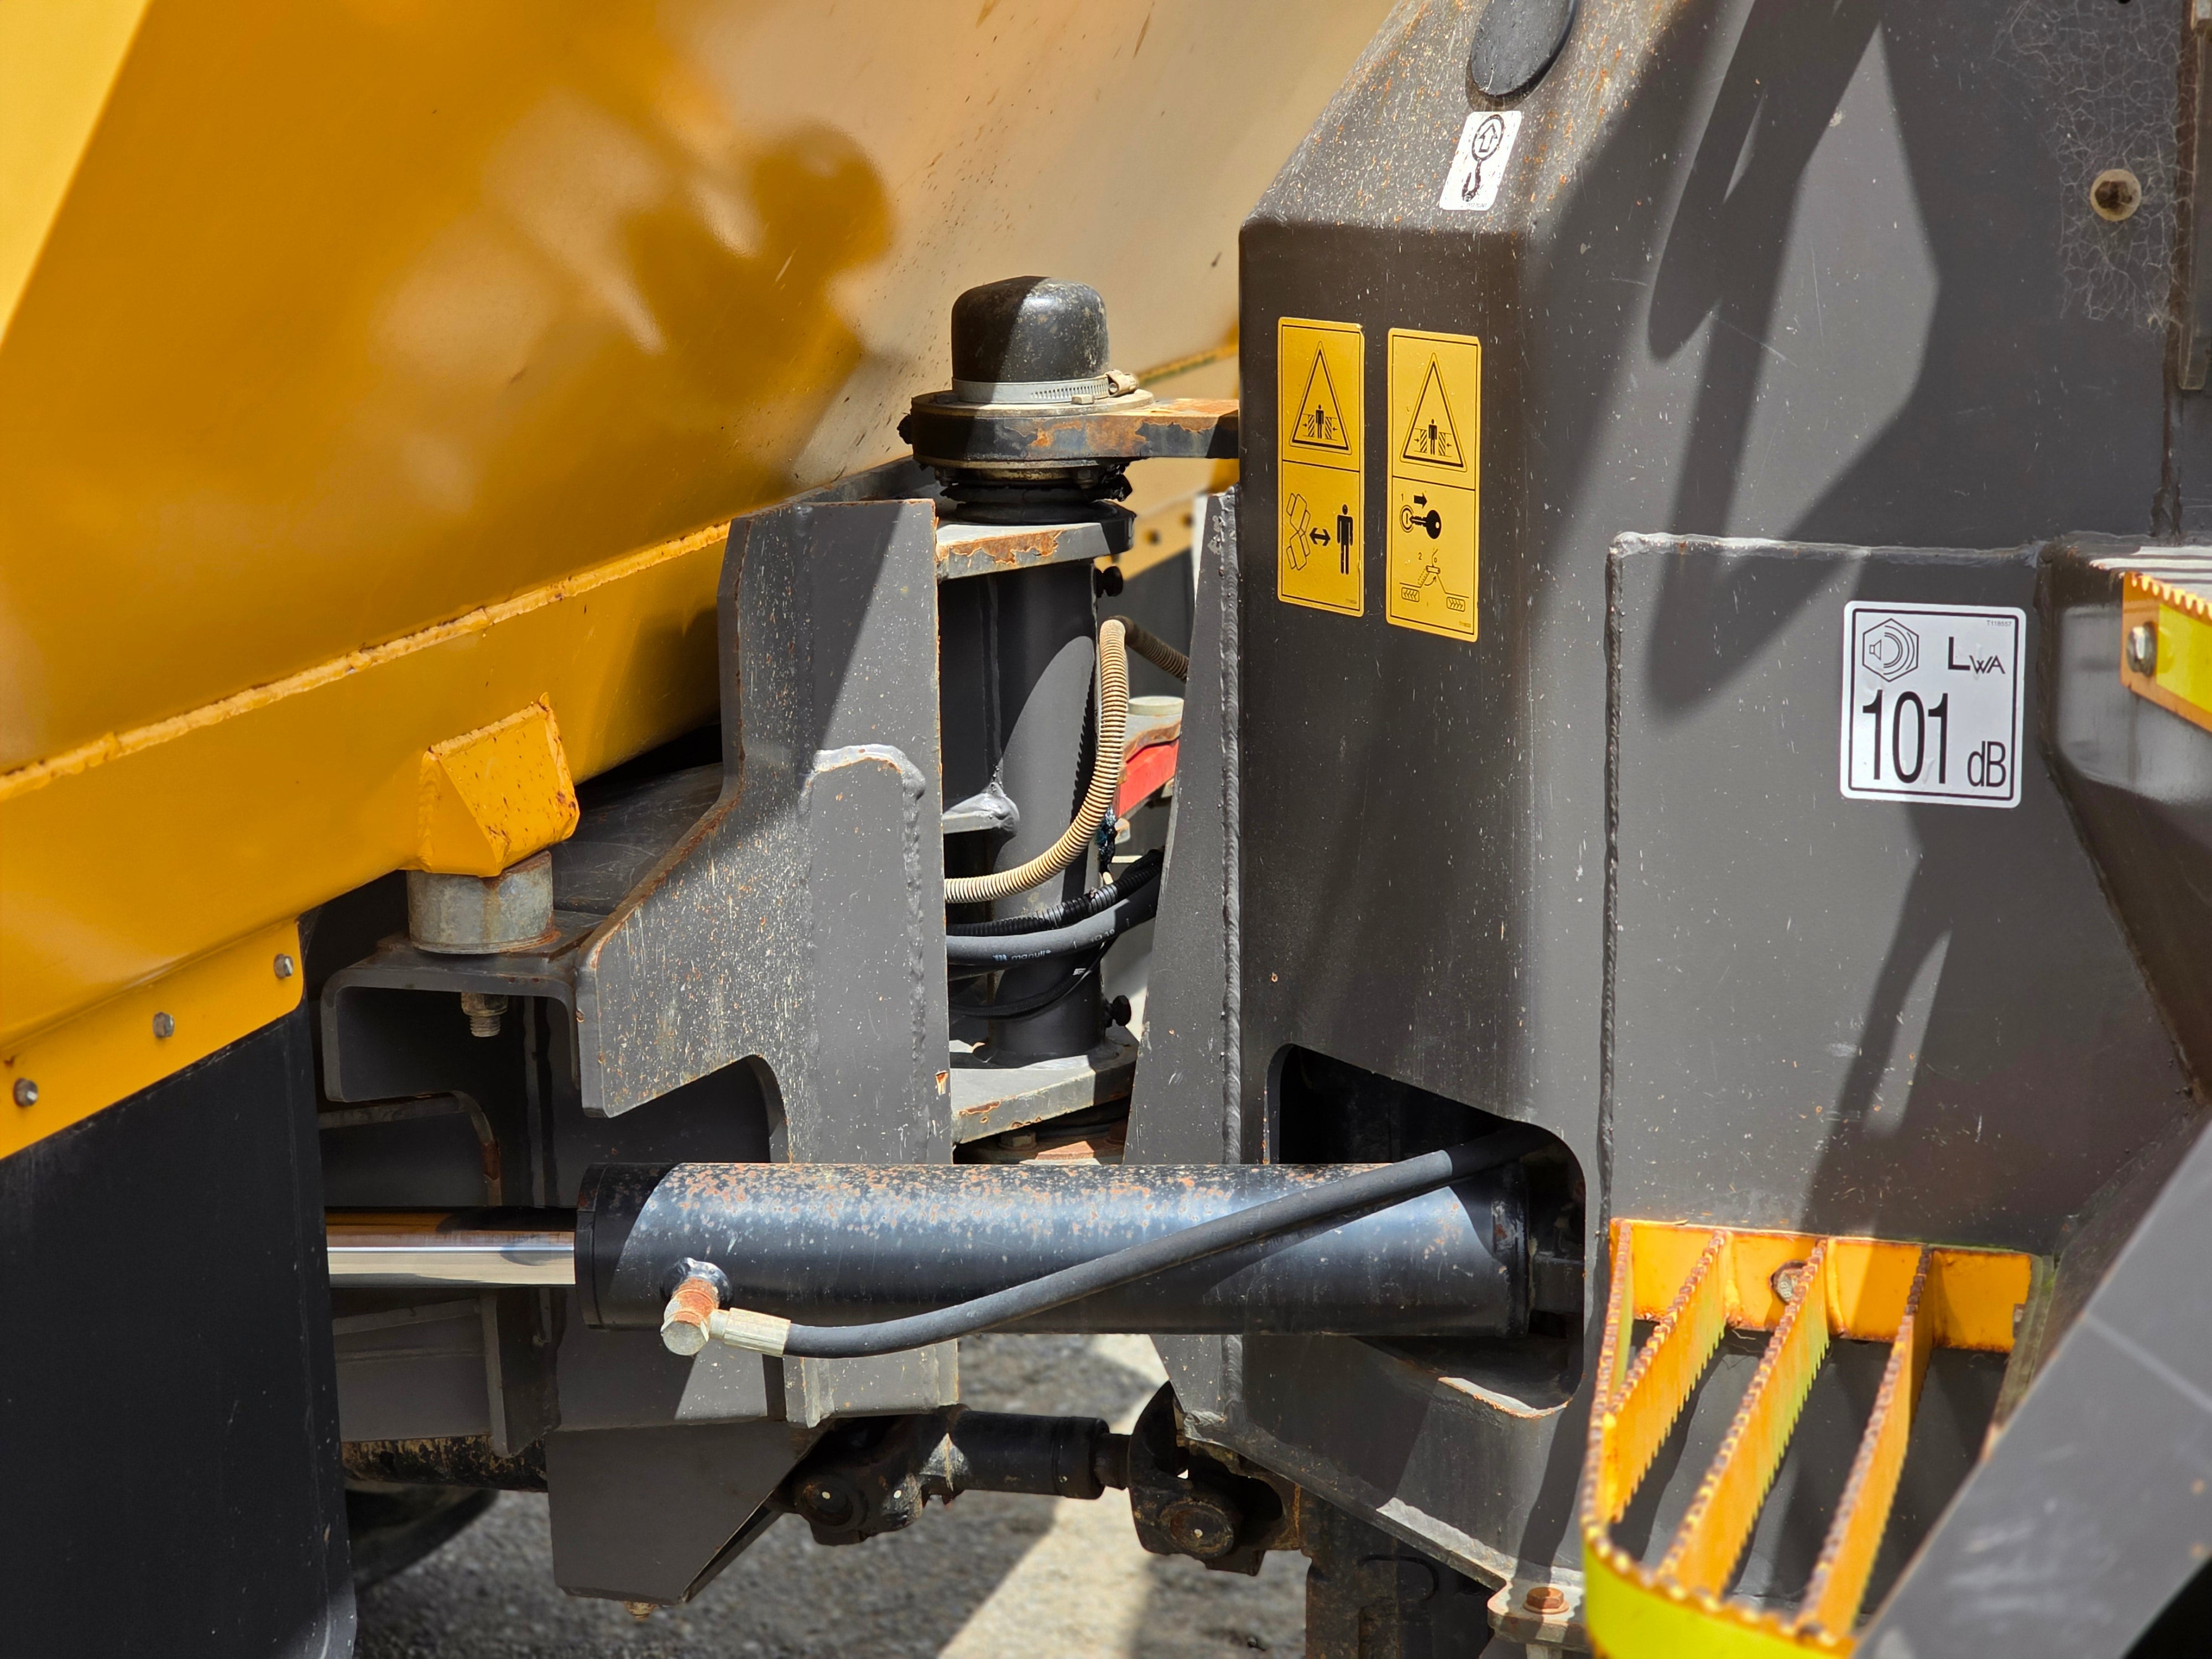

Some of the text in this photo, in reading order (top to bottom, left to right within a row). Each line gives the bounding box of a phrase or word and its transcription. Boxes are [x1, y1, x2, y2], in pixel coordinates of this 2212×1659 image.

[1418, 552, 1422, 560] 2
[1862, 689, 2007, 787] 101 dB
